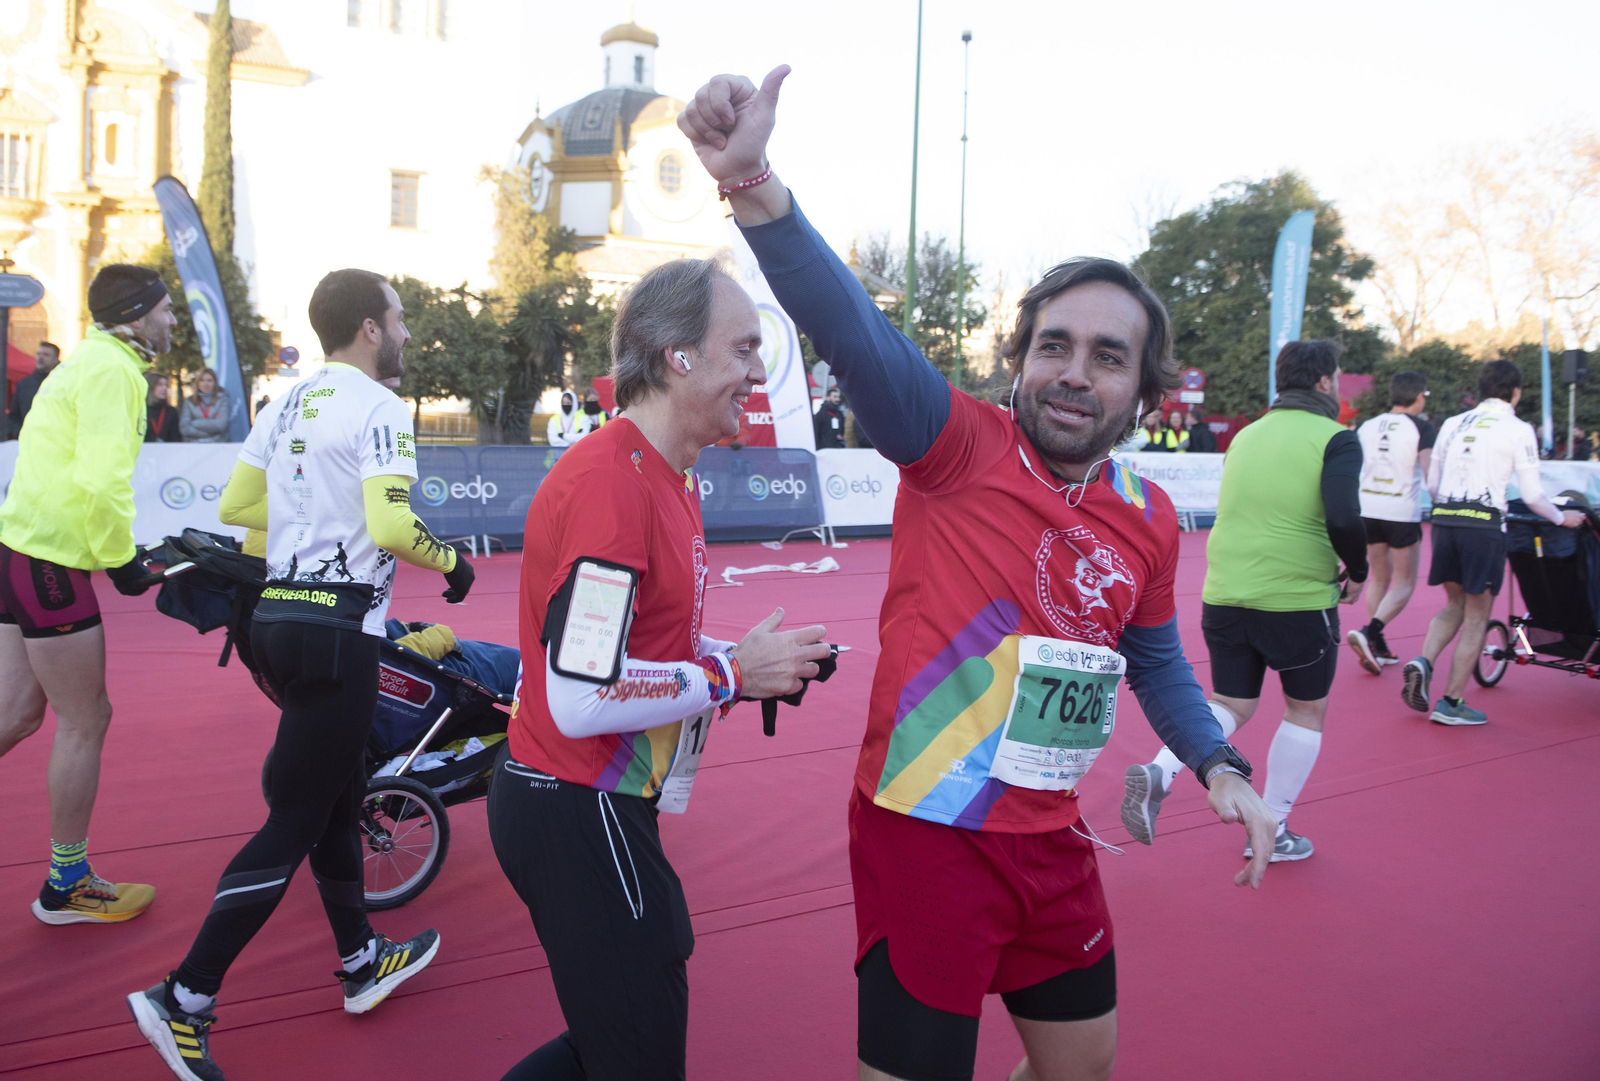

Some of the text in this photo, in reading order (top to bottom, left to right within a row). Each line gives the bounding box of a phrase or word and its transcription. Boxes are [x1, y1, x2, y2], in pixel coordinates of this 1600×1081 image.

[397, 441, 407, 449] DE
[450, 474, 499, 505] edp
[770, 473, 807, 500] edp
[851, 474, 883, 499] edp
[1055, 647, 1078, 667] edp
[610, 679, 681, 703] Sightseeing
[1038, 676, 1104, 725] 7626
[530, 780, 560, 790] DRI-FIT
